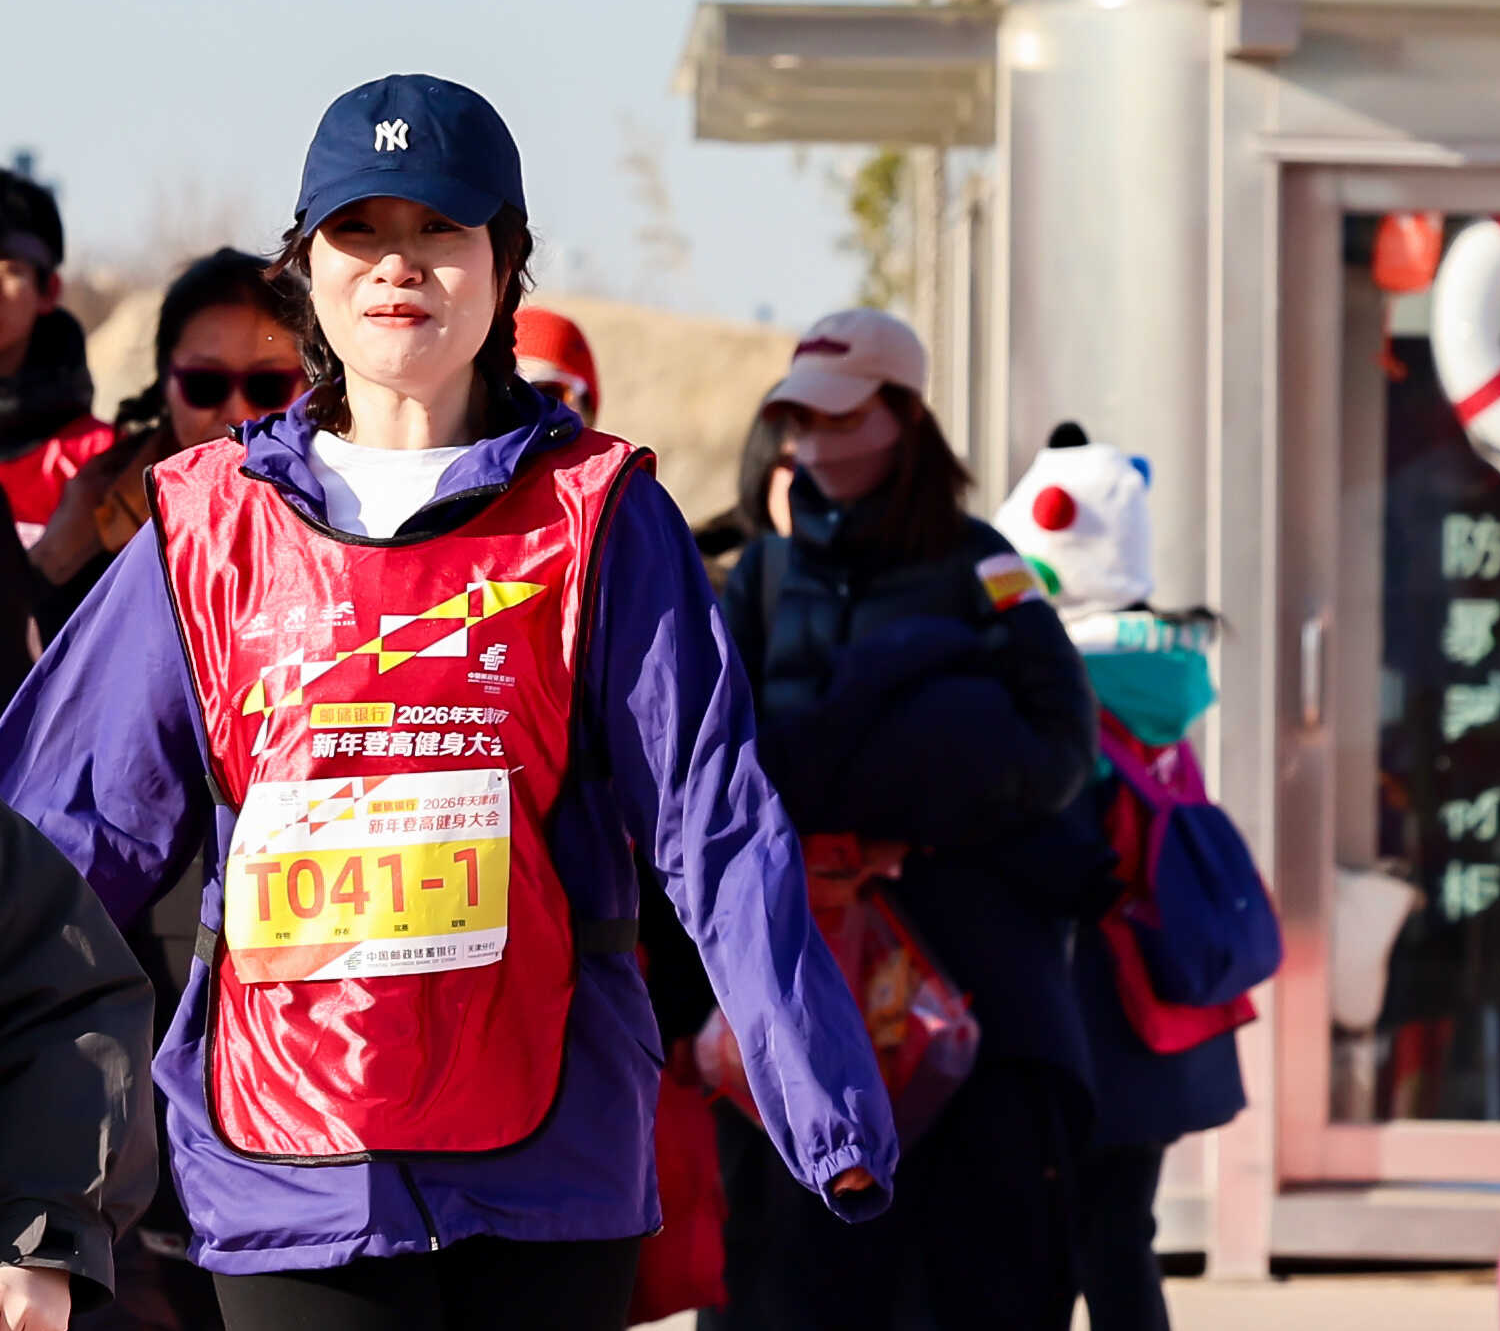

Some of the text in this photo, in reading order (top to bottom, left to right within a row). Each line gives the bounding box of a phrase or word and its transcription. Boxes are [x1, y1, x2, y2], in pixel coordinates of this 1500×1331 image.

[423, 794, 500, 811] 2026年天津市
[368, 811, 501, 835] 新年登高健身大会
[245, 847, 480, 922] T041-1
